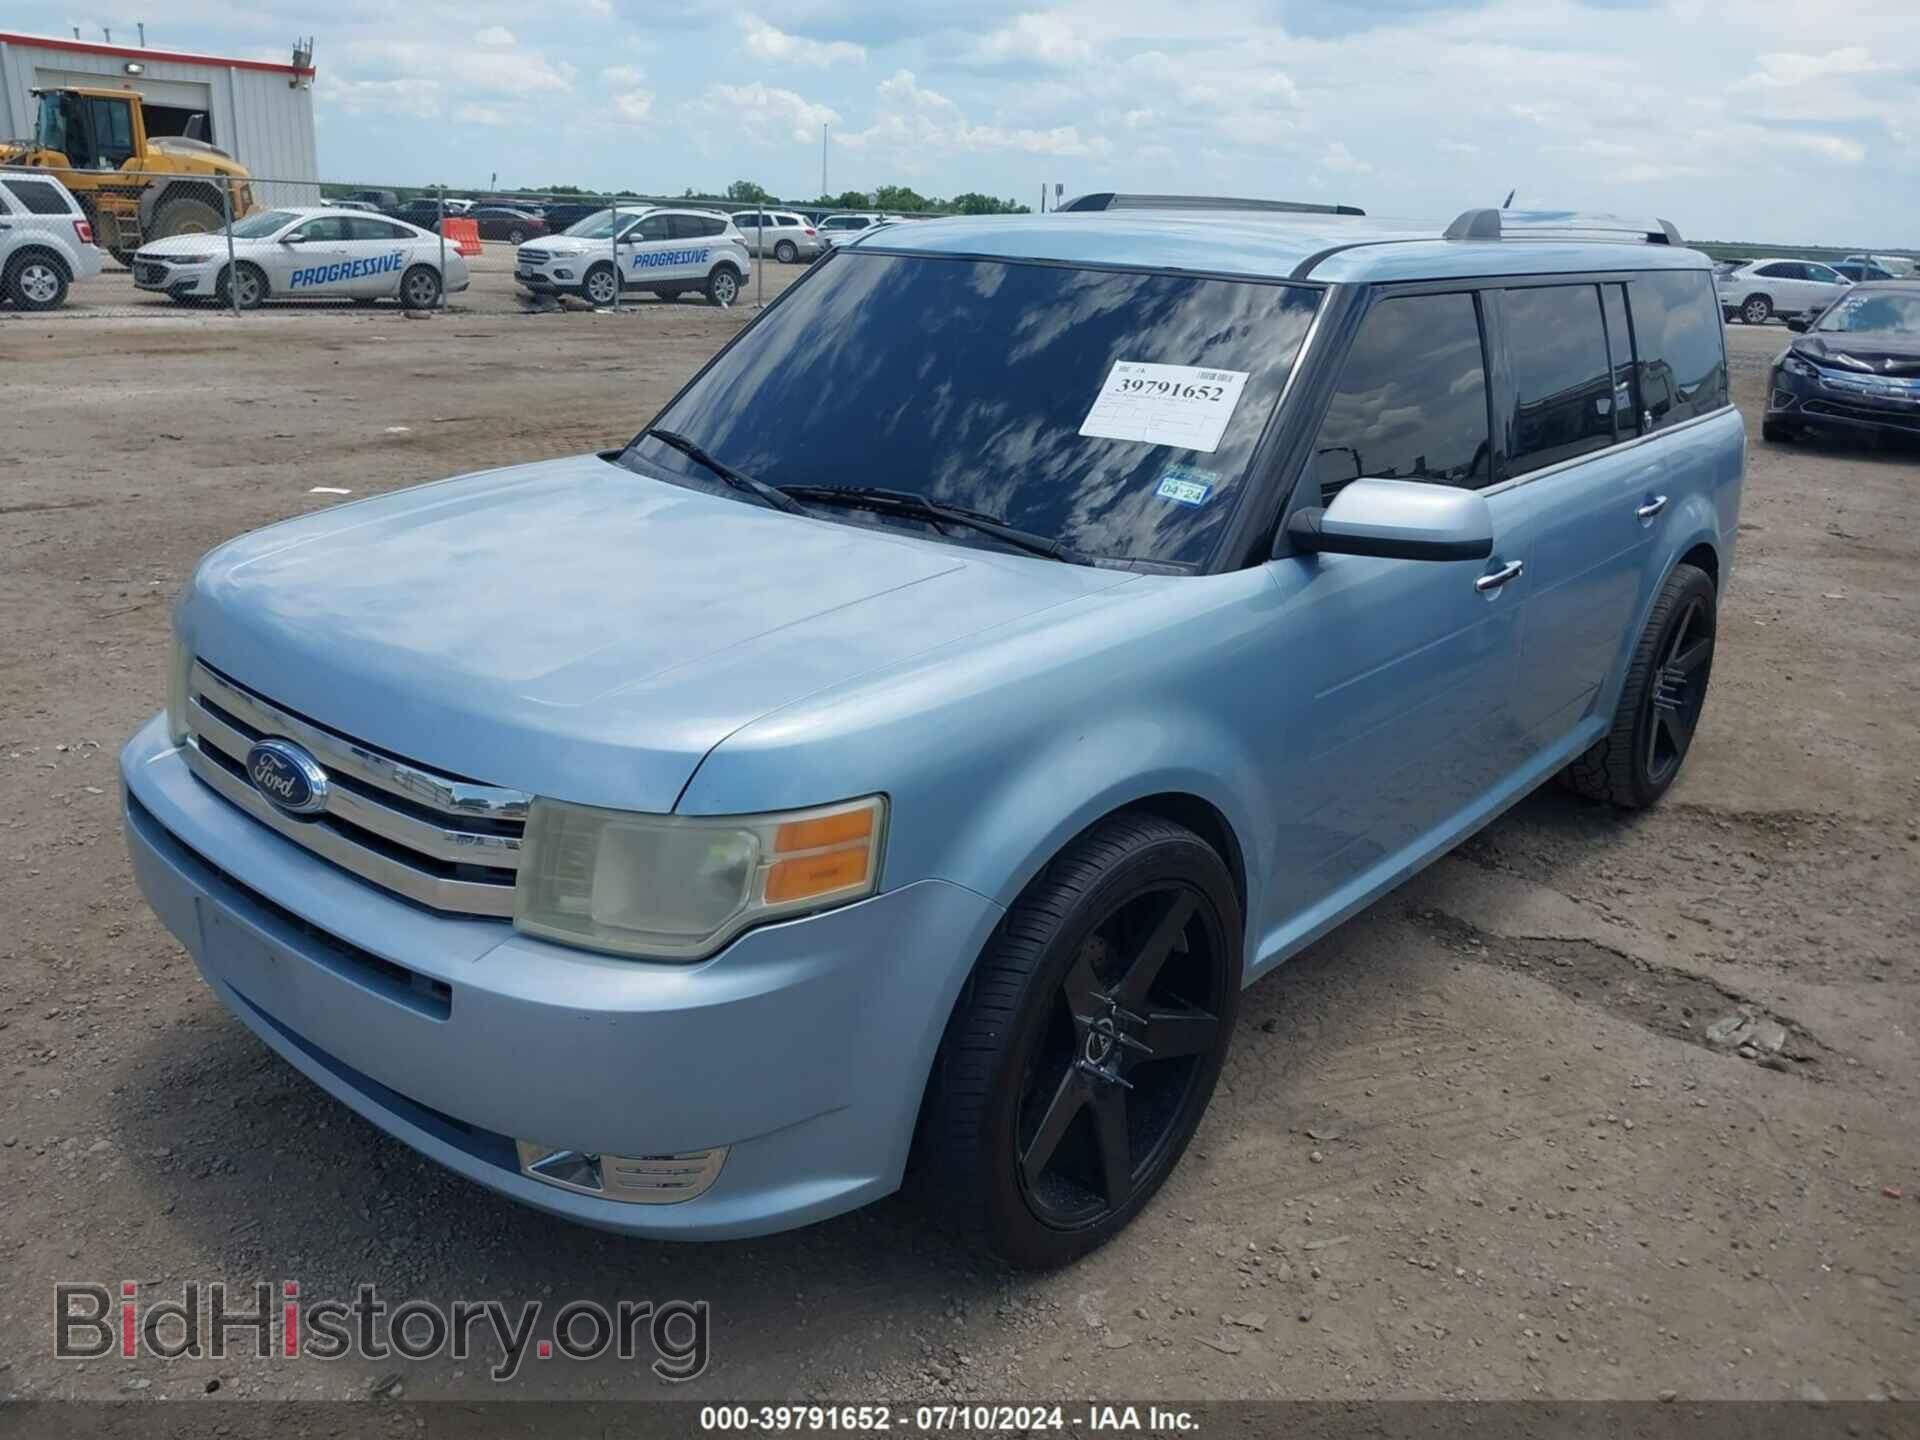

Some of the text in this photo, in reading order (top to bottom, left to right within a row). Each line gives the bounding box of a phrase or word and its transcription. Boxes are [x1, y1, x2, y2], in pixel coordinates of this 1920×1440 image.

[290, 253, 402, 289] PROGRESSIVE
[632, 248, 710, 269] PROGRESSIVE
[1115, 378, 1223, 402] 39791652
[255, 753, 296, 798] Ford
